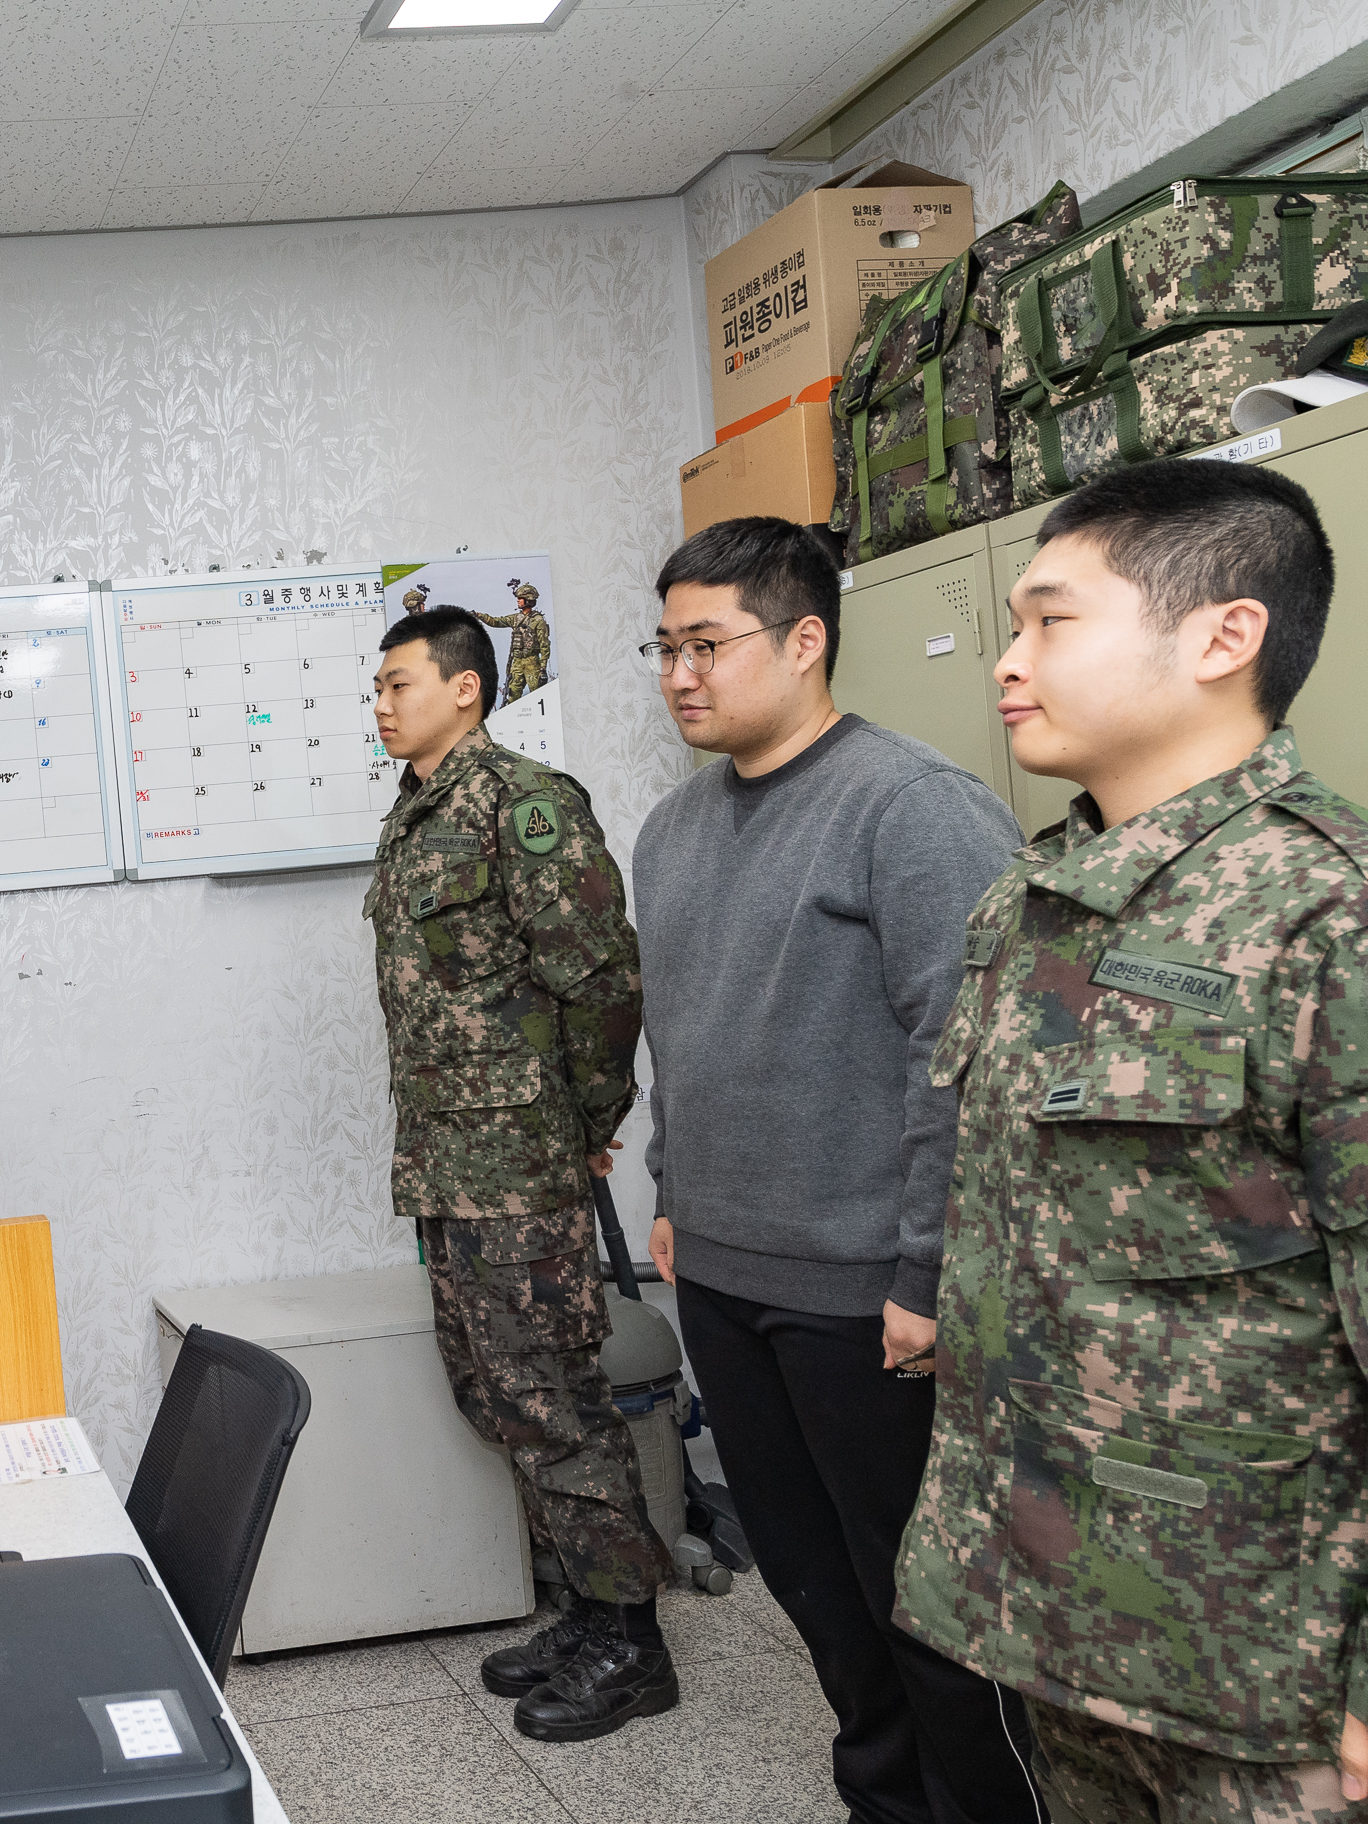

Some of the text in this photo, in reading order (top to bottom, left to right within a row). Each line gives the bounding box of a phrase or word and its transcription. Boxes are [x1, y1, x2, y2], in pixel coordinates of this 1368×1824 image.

[854, 218, 877, 227] 6.5 oz
[721, 247, 806, 315] 고급 일회용 위생 종이컵
[722, 273, 809, 350] 피원종이컵
[743, 346, 761, 365] F&B
[245, 593, 253, 606] 3
[310, 601, 350, 609] SCHEDULE
[303, 658, 310, 670] 6
[359, 655, 365, 665] 7
[184, 667, 193, 679] 4
[243, 663, 251, 674] 5
[128, 671, 137, 682] 3
[303, 698, 315, 709] 13
[360, 694, 372, 704] 14
[188, 707, 200, 718] 11
[245, 704, 258, 713] 12
[537, 698, 545, 716] 1
[130, 711, 142, 723] 10
[307, 738, 320, 747] 20
[364, 733, 376, 743] 21
[250, 743, 262, 753] 19
[519, 740, 547, 751] 4 5
[133, 750, 143, 762] 17
[192, 747, 202, 757] 18
[309, 777, 322, 787] 27
[368, 772, 380, 781] 28
[194, 786, 206, 796] 25
[253, 781, 266, 791] 26
[154, 829, 192, 838] REMARKS
[1099, 958, 1222, 1002] 대한민국 육군 ROKA
